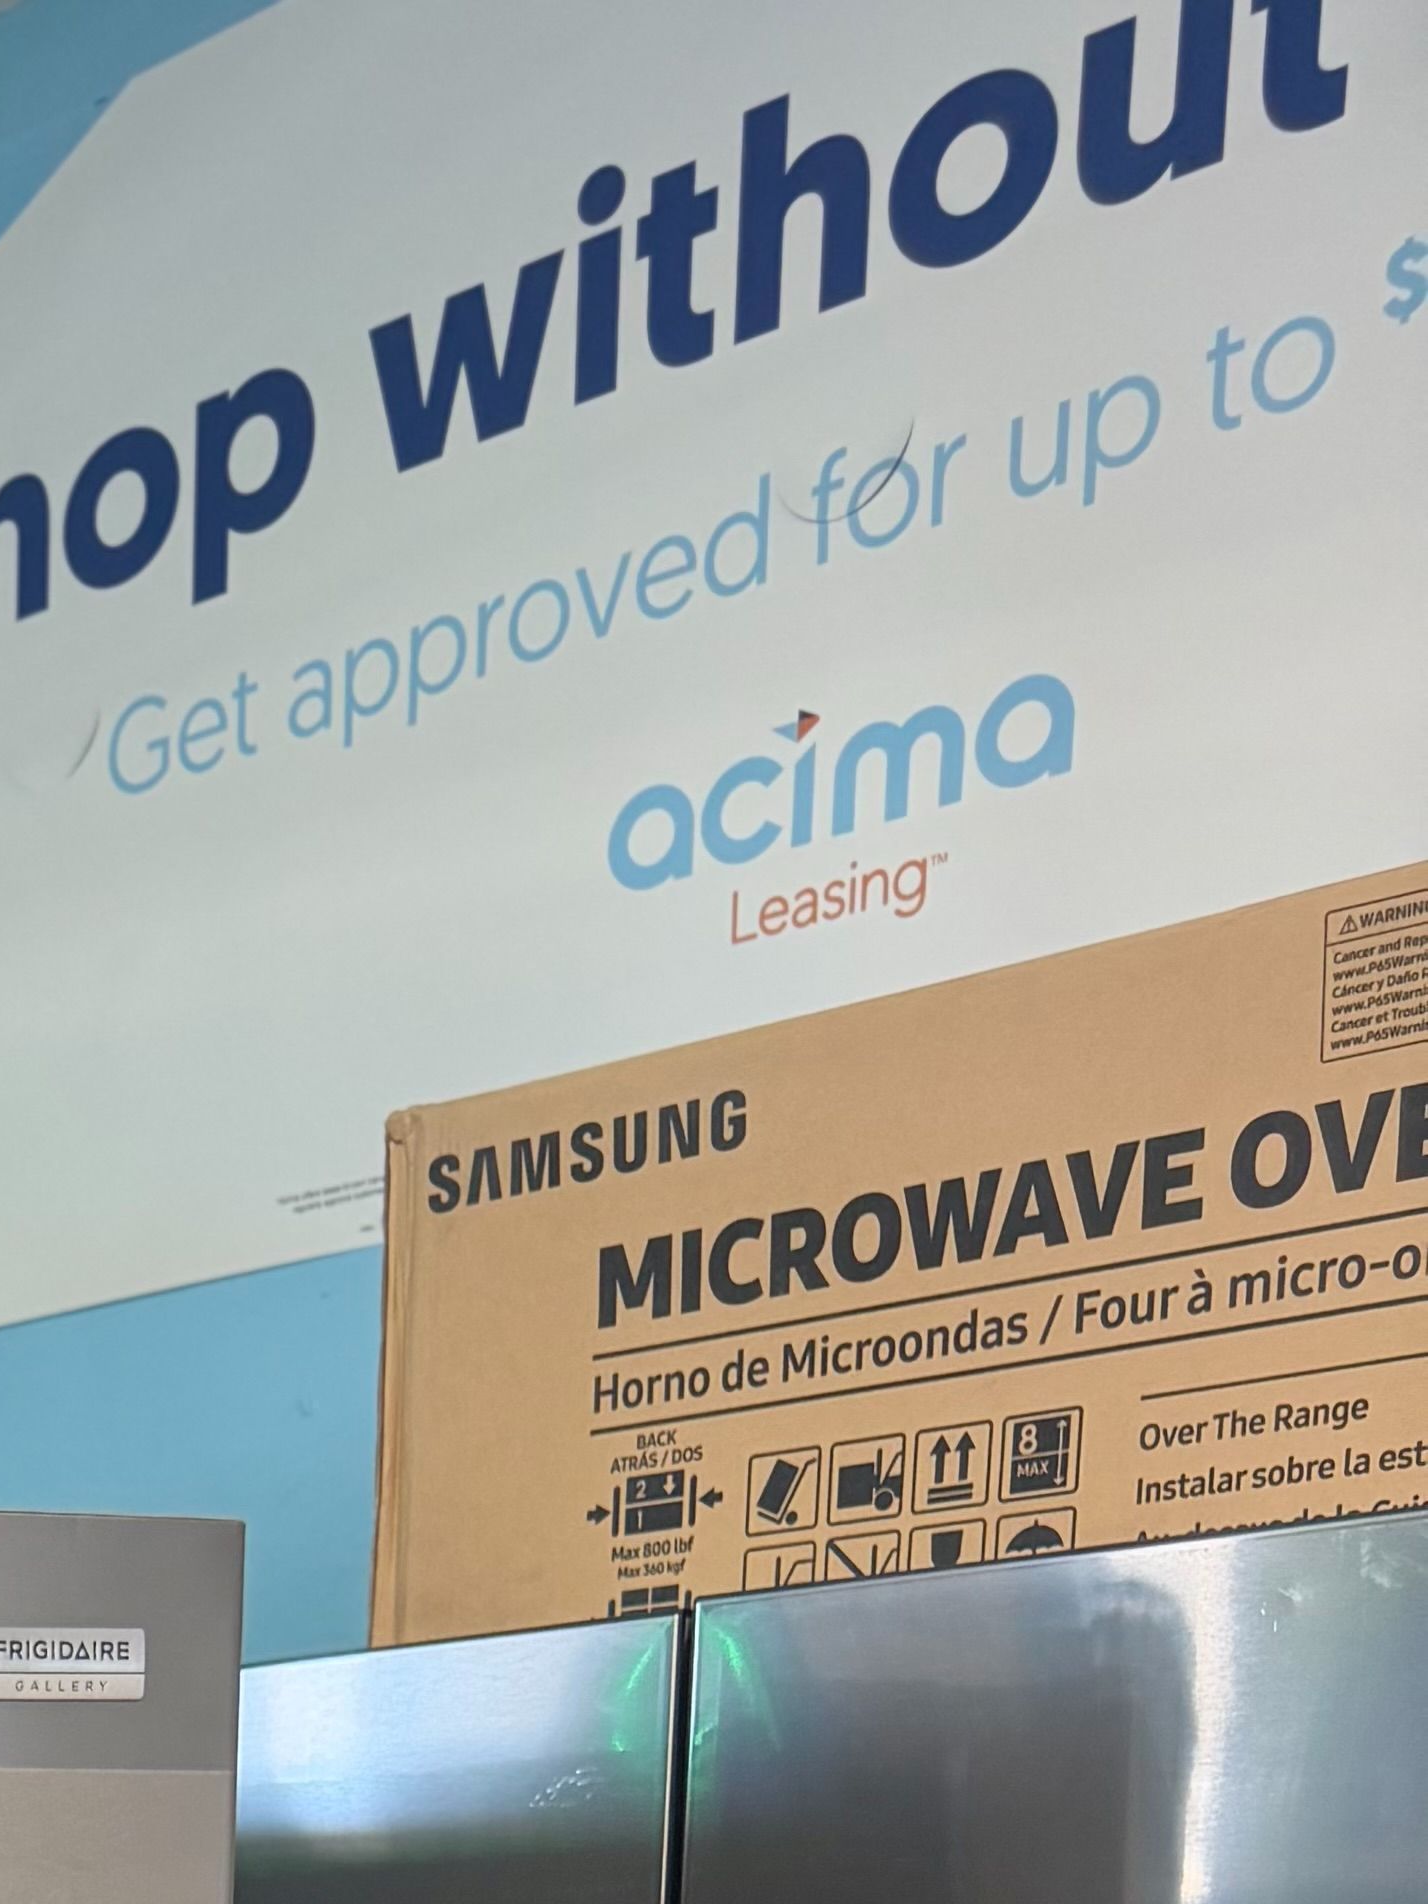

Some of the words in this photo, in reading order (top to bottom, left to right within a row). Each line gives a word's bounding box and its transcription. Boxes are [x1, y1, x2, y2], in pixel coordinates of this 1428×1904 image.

[369, 0, 1349, 474] without
[108, 672, 258, 794] Get
[288, 473, 771, 747] approved
[812, 432, 967, 566] for
[1008, 374, 1160, 506] up
[1205, 315, 1336, 432] to
[607, 673, 1076, 891] acima
[1360, 901, 1428, 928] WARNIN
[1334, 946, 1375, 964] Cancer
[1378, 938, 1401, 954] and
[1404, 934, 1428, 952] Rep
[1332, 985, 1428, 1016] www.P65Warni
[1331, 1015, 1373, 1033] Cancer
[1376, 1012, 1388, 1024] et
[426, 1088, 749, 1214] SAMSUNG
[596, 1127, 1206, 1330] MICROWAVE
[1230, 1082, 1428, 1210] OVE
[591, 1364, 711, 1415] Horno
[719, 1350, 770, 1395] de
[780, 1305, 1028, 1381] Microondas
[1074, 1277, 1180, 1336] Four
[1191, 1268, 1214, 1315] à
[1227, 1240, 1428, 1308] micro-o
[636, 1429, 677, 1450] BACK
[1019, 1423, 1039, 1455] 8
[1139, 1420, 1209, 1452] Over
[1213, 1409, 1266, 1441] The
[1274, 1398, 1369, 1433] Range
[610, 1452, 658, 1475] ATRÁS
[672, 1445, 703, 1465] DOS
[1016, 1460, 1049, 1479] MAX
[1136, 1467, 1248, 1505] Instalar
[1252, 1456, 1336, 1490] sobre
[1344, 1448, 1370, 1477] la
[1379, 1441, 1428, 1471] est
[611, 1546, 640, 1563] Max
[15, 1680, 109, 1693] GALLERY
